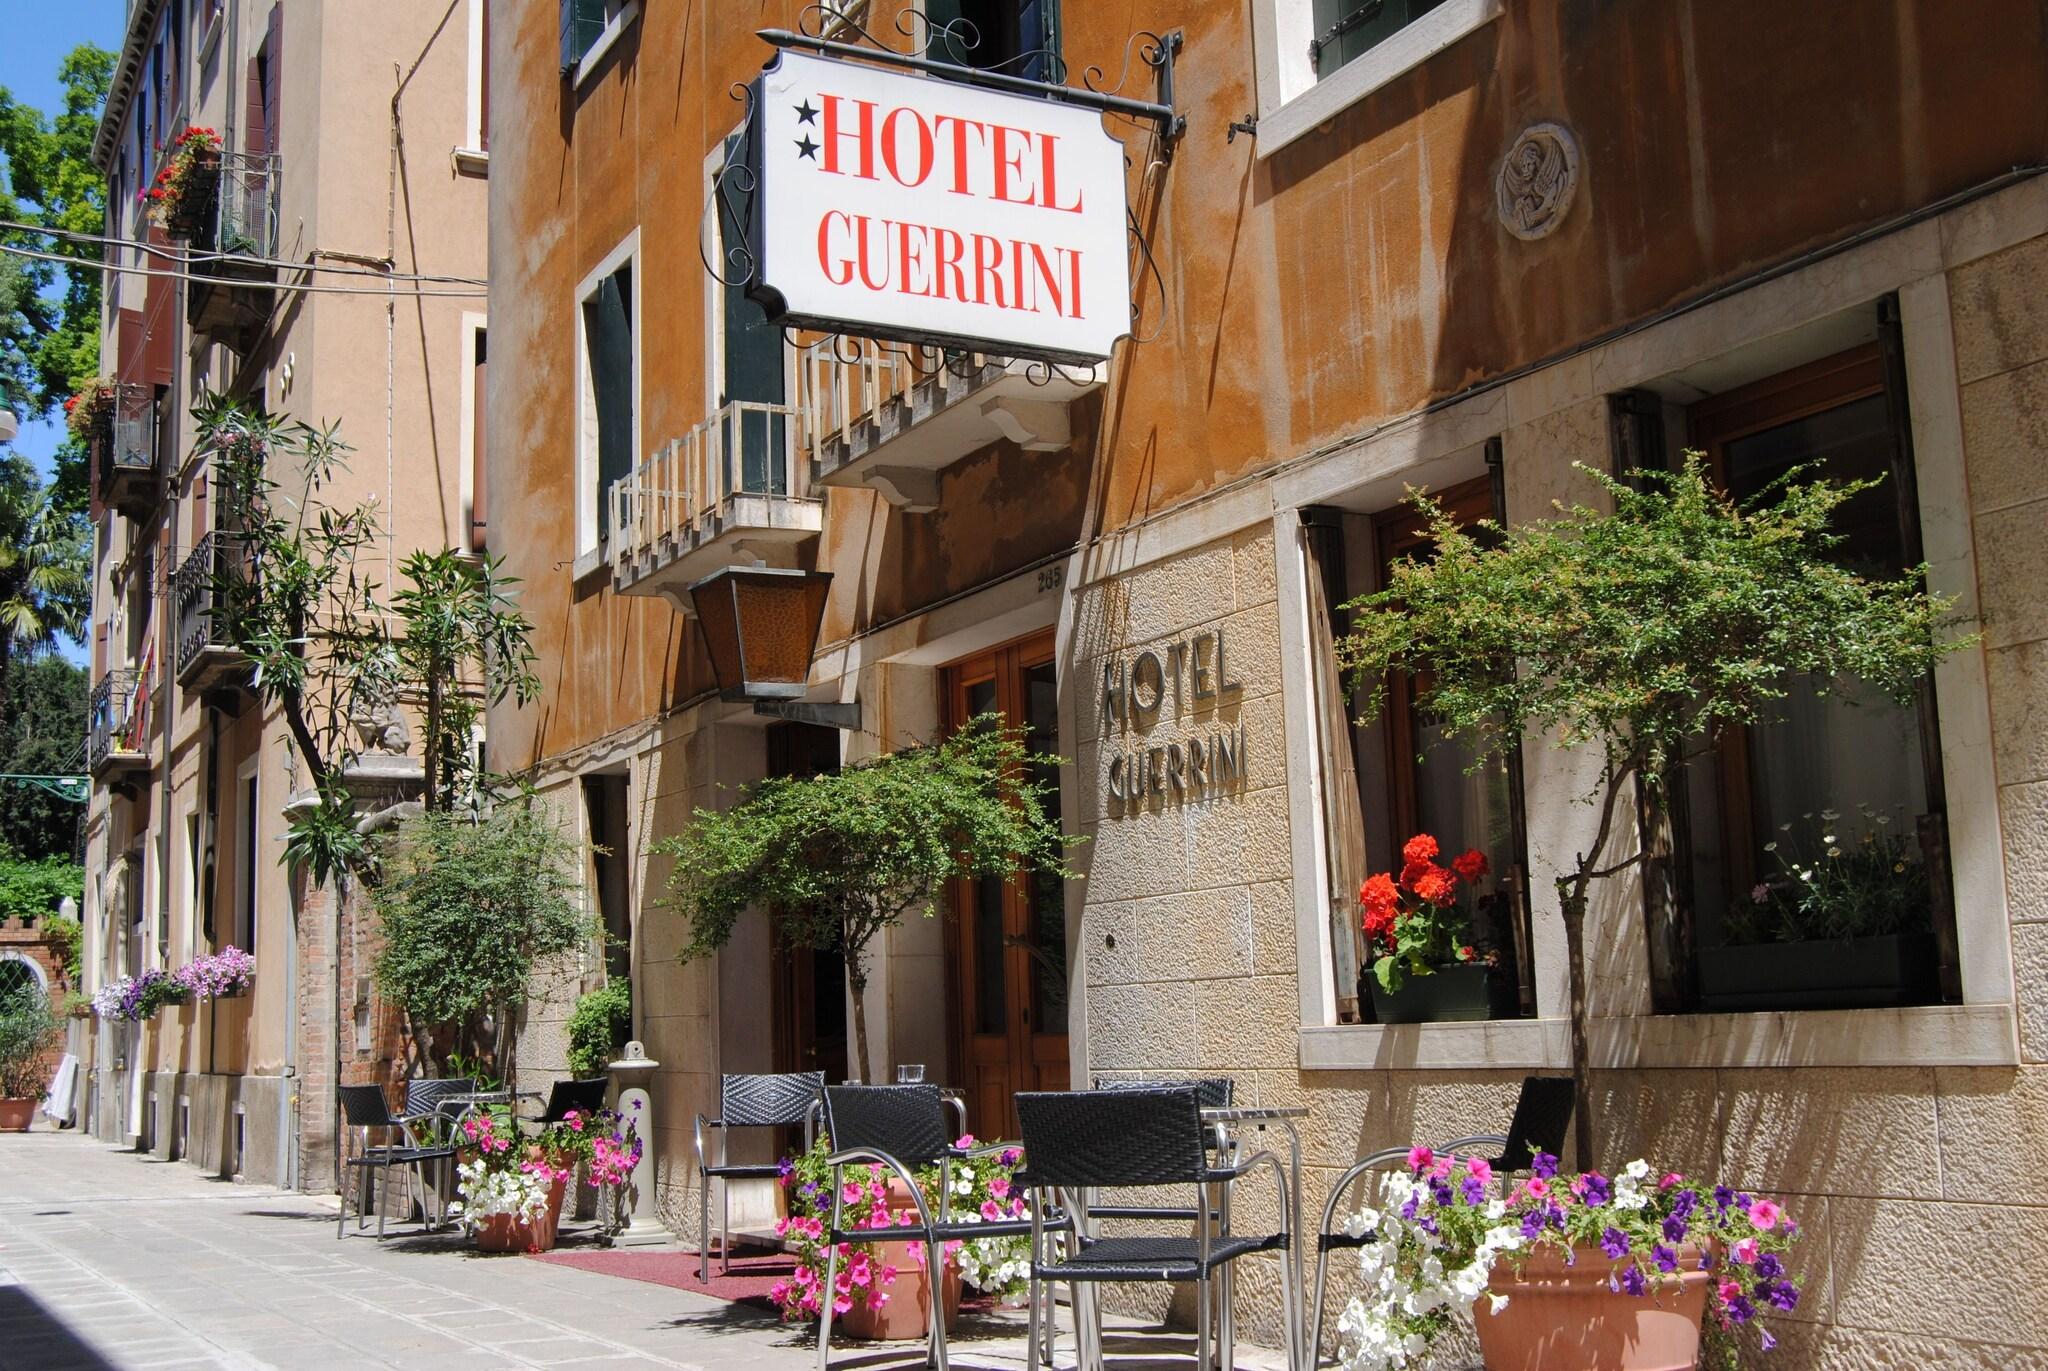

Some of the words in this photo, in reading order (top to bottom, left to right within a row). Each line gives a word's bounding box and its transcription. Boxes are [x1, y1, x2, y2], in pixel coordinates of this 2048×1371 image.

[817, 93, 1083, 213] HOTEL
[817, 210, 1085, 320] GUERRINI
[1104, 629, 1242, 725] HOTEL
[1109, 724, 1247, 800] GUERRINI
